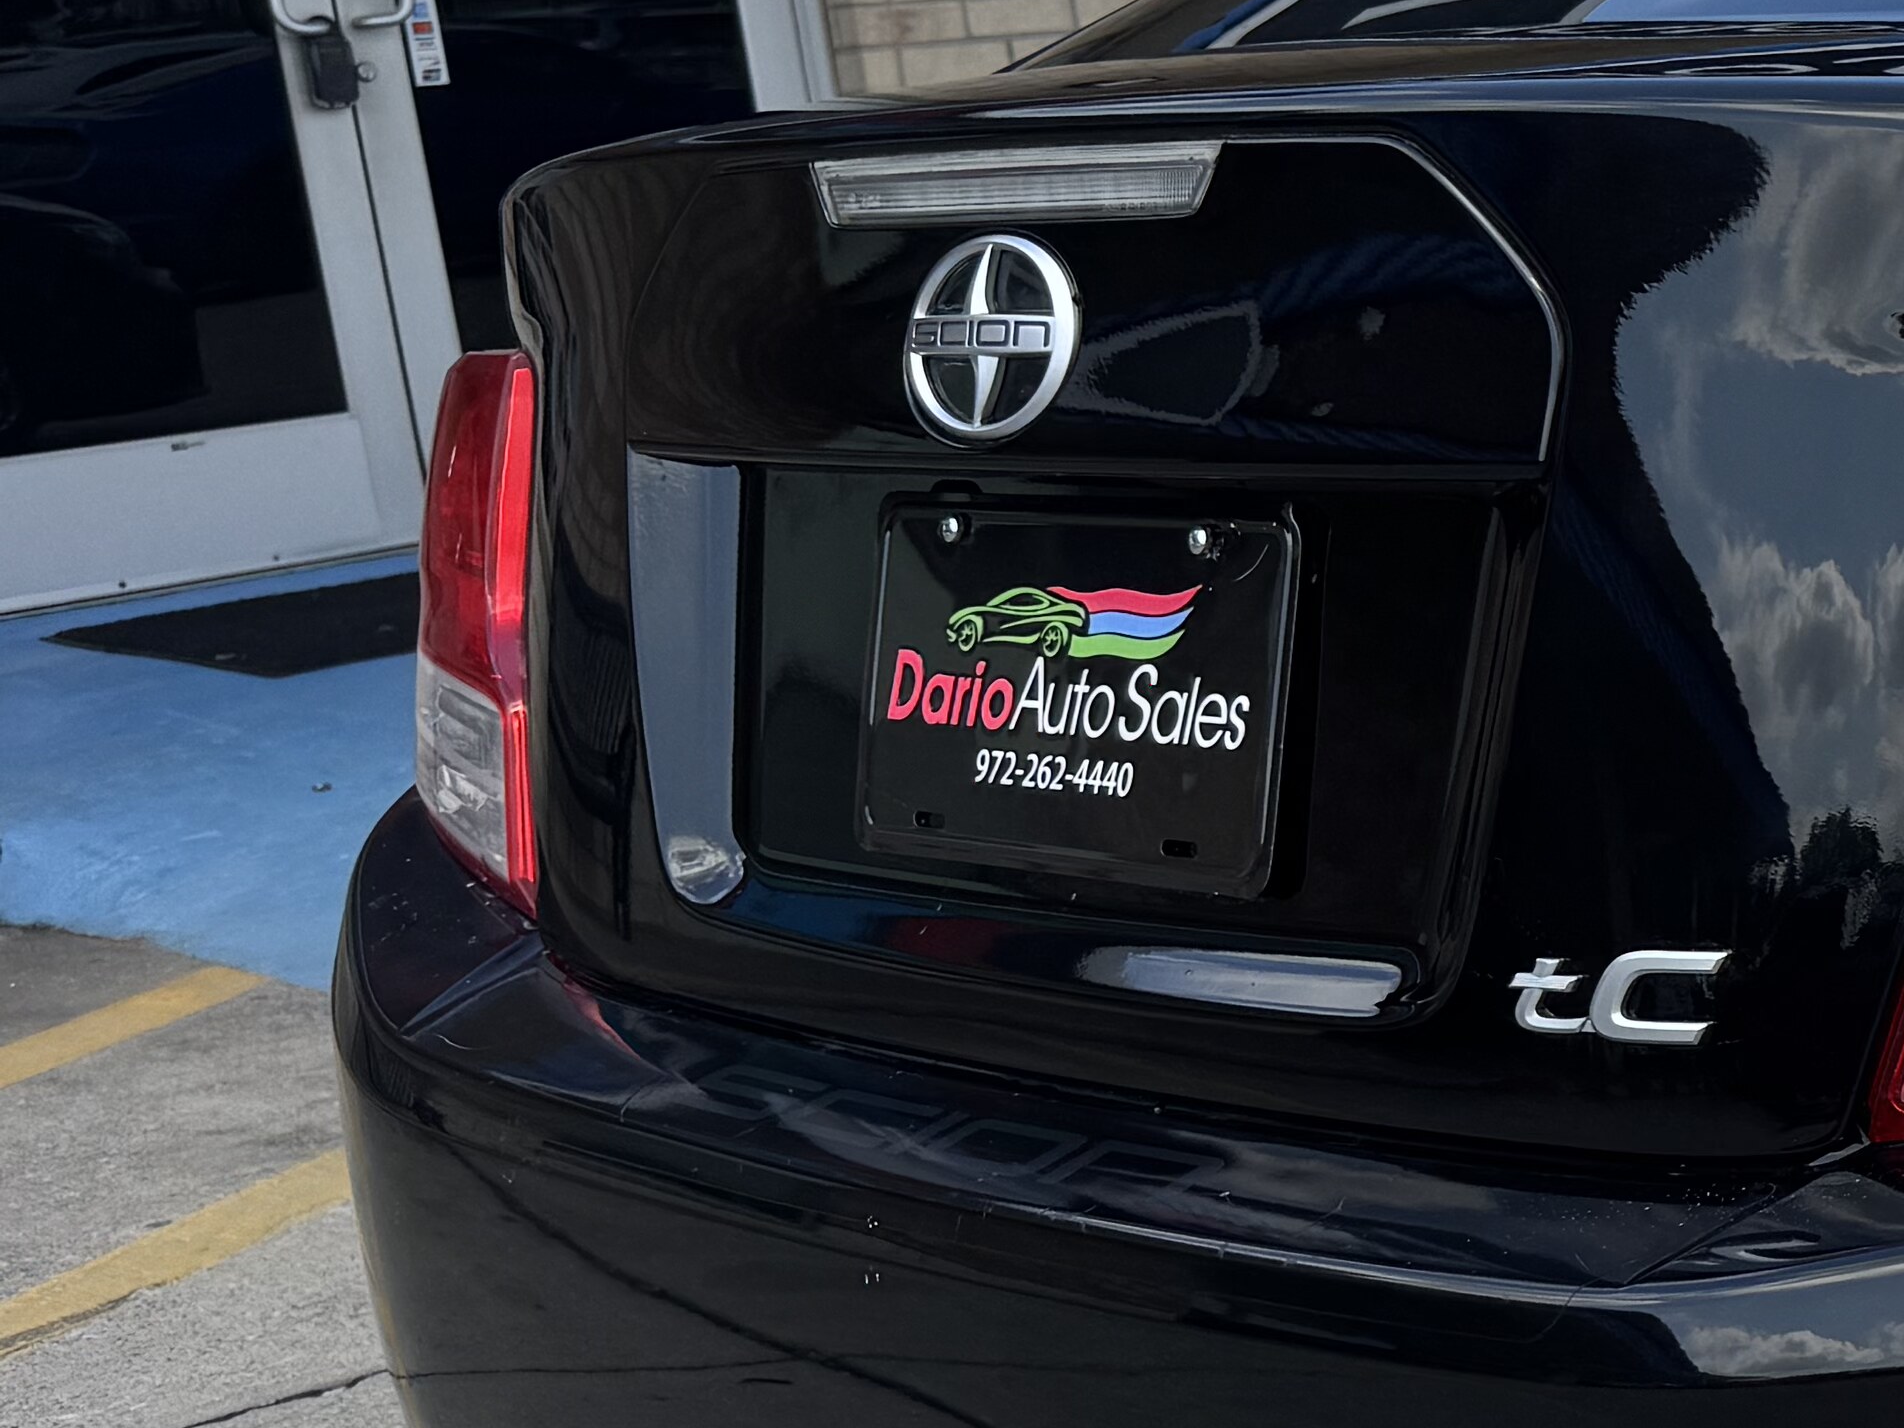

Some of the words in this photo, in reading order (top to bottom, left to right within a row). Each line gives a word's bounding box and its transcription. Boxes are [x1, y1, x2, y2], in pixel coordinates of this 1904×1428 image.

[887, 648, 1014, 731] Dario
[1008, 656, 1116, 739] Auto
[1118, 664, 1250, 751] Sales
[975, 748, 1134, 798] 972-262-4440
[1508, 949, 1733, 1046] tC
